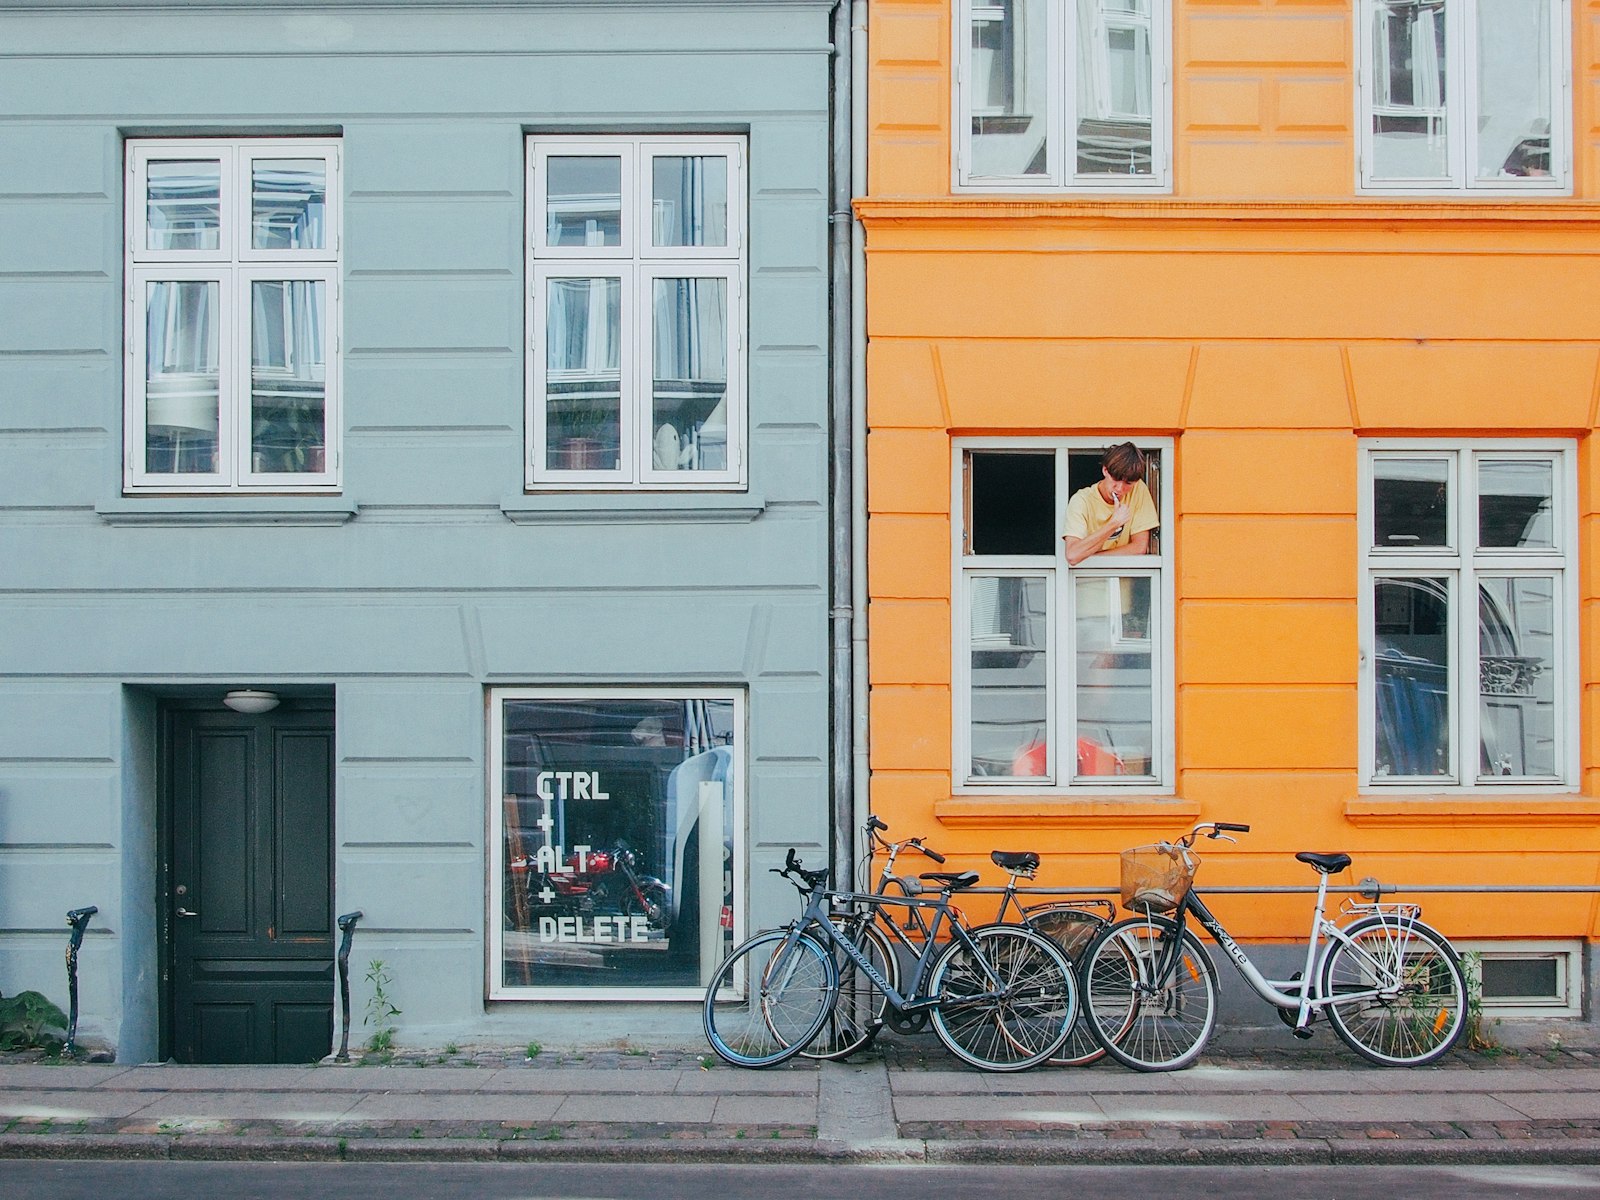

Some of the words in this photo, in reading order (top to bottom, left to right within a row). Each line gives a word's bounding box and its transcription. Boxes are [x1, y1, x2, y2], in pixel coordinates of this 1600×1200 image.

[537, 771, 609, 800] CTRL
[537, 845, 591, 873] ALT
[539, 916, 649, 942] DELETE
[831, 925, 892, 991] CENTURION
